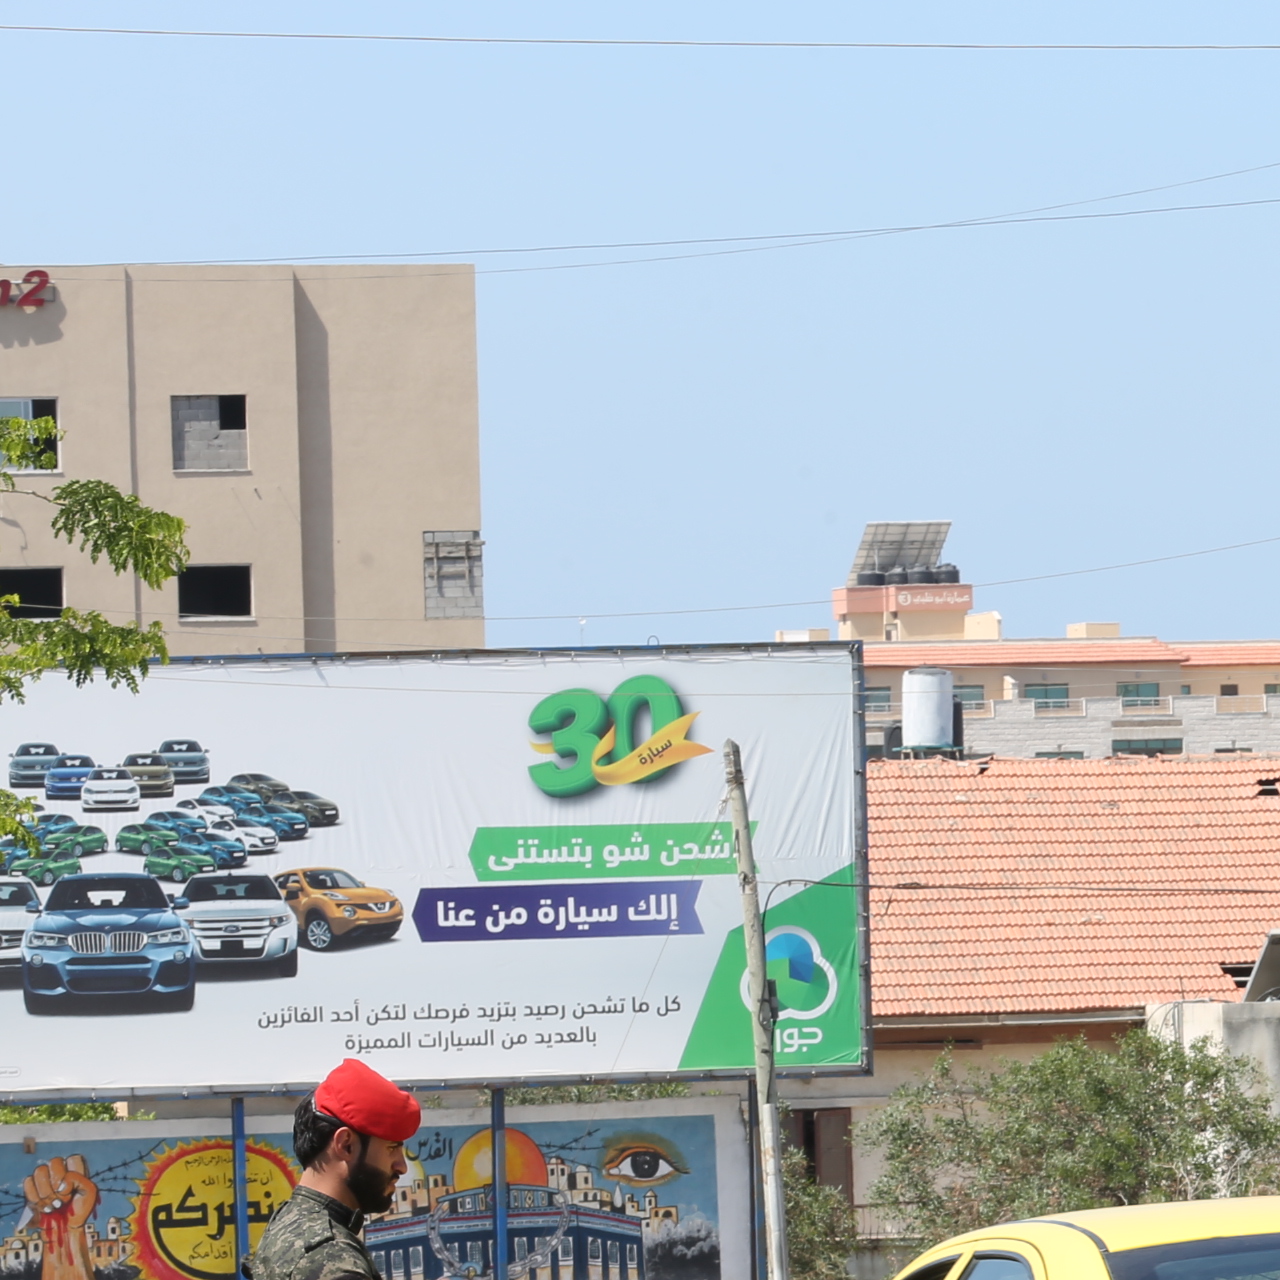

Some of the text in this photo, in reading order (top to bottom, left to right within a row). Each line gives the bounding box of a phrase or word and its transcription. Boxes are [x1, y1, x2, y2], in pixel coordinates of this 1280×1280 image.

[528, 674, 685, 798] 30
[638, 738, 674, 766] سيارة
[487, 829, 739, 871] شحن شو بتستنى
[436, 894, 680, 933] إلك سيارة من عنا
[257, 995, 682, 1029] كل ما تشحن رصيد بتزيد فرصك لتكن أحد الفائزين
[344, 1026, 597, 1054] بالعديد من السيارات المميزة
[775, 1027, 823, 1053] جوا
[405, 1131, 453, 1162] القدس
[201, 1174, 220, 1187] الله
